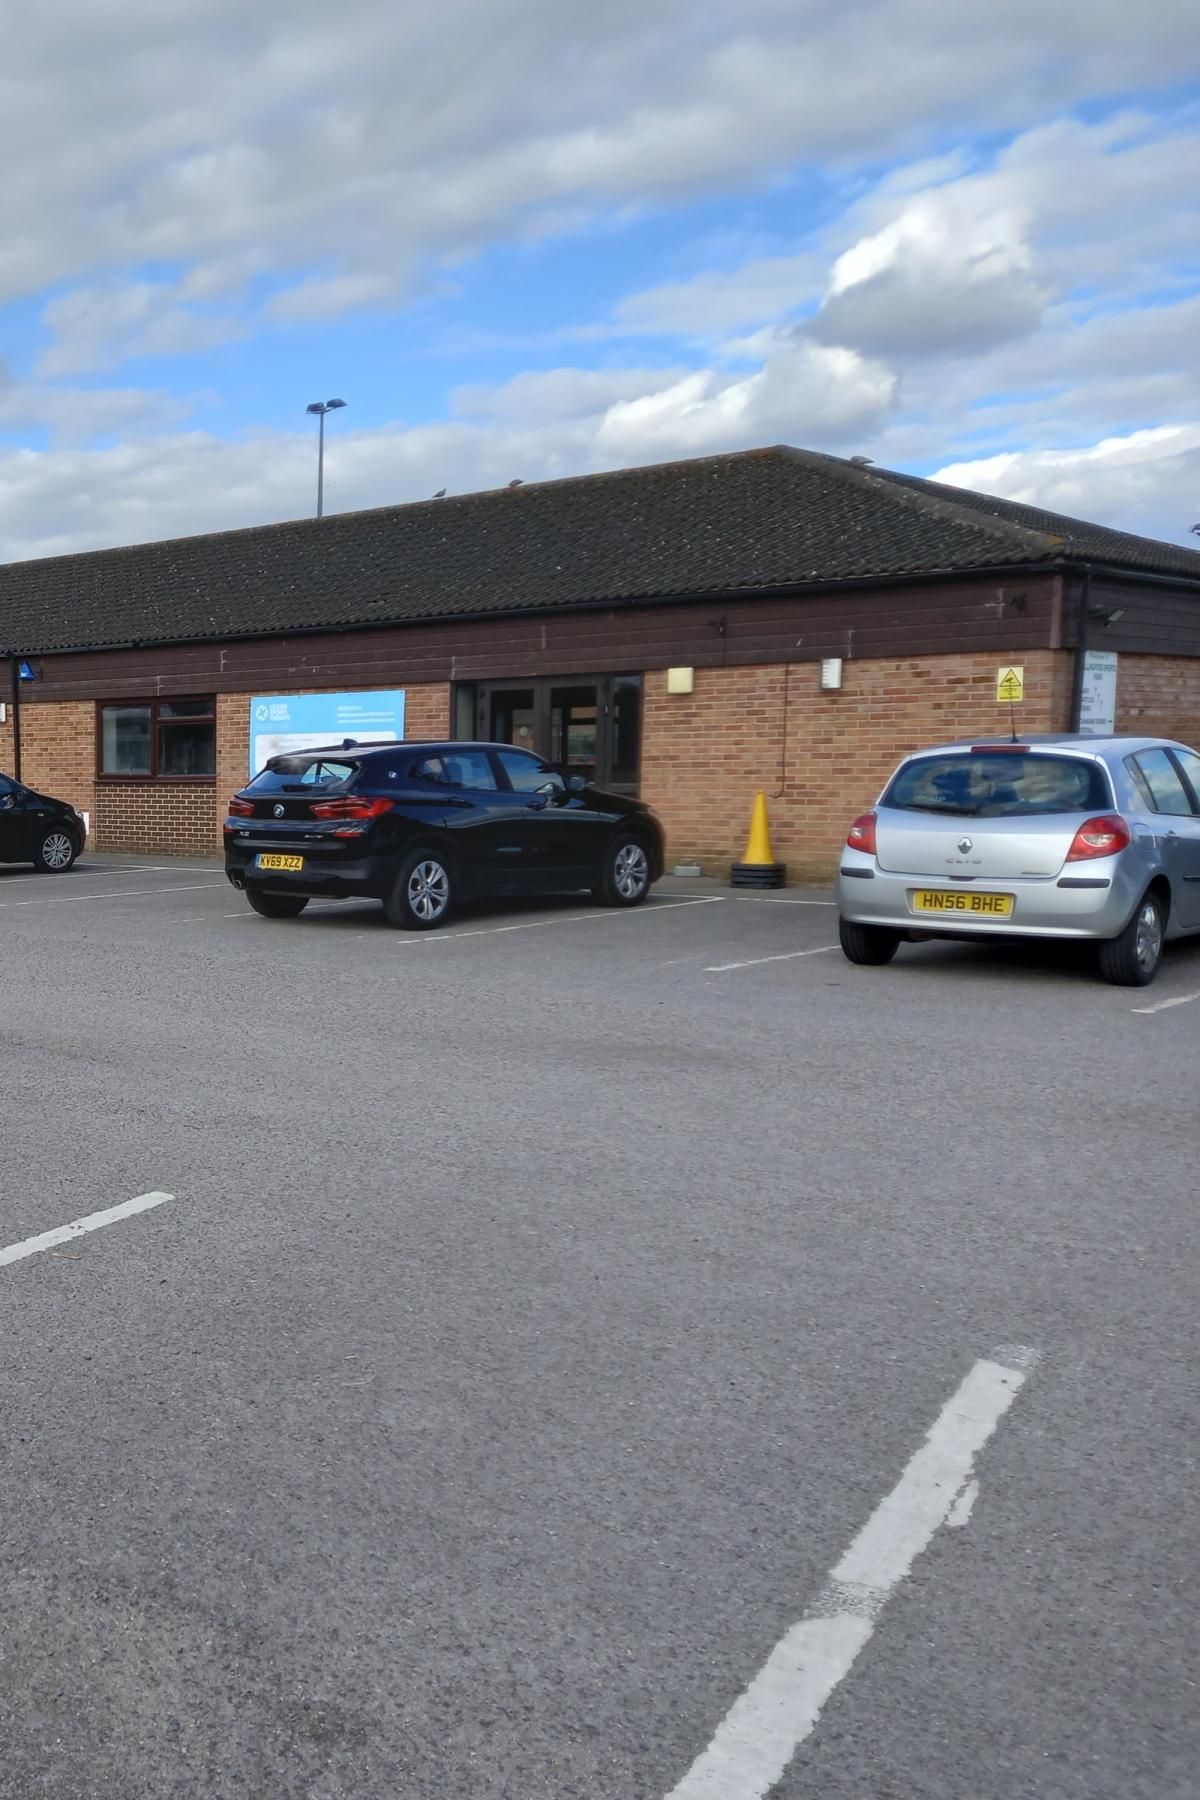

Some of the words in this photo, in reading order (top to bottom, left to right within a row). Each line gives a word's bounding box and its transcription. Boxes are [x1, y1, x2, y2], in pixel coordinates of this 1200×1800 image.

[260, 855, 281, 868] KV69
[283, 857, 301, 868] XZZ
[922, 893, 966, 910] HN56
[970, 895, 1005, 913] BHE
